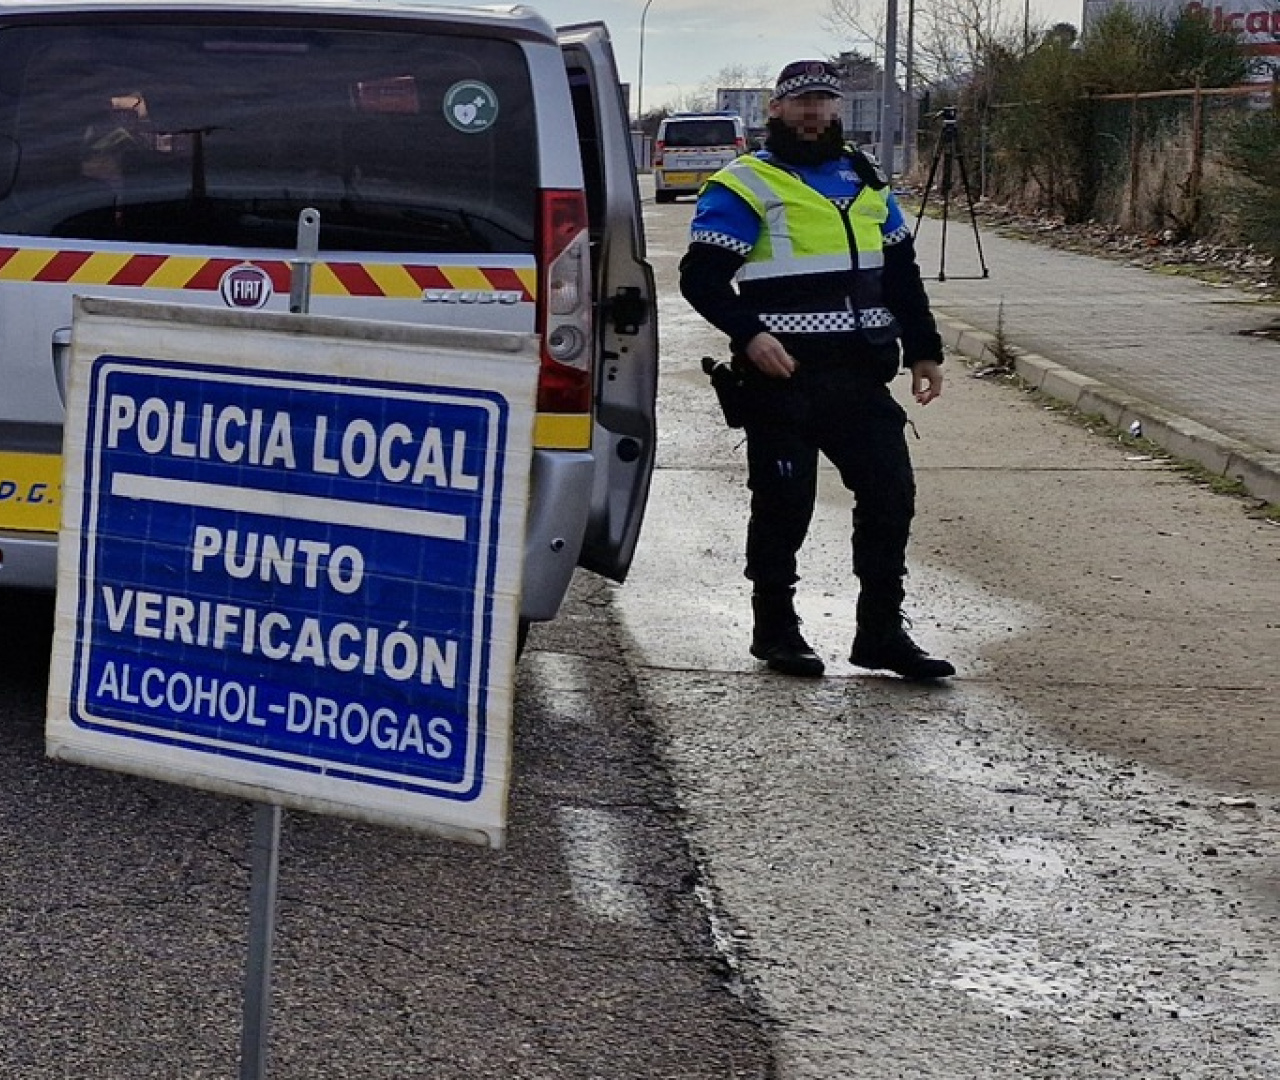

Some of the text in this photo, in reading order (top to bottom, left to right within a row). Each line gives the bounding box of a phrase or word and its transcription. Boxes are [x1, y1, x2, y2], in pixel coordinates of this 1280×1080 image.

[233, 279, 261, 300] FIAT
[106, 394, 480, 491] POLICIA LOCAL
[192, 526, 364, 594] PUNTO
[102, 587, 458, 688] VERIFICACIÓN
[96, 660, 452, 760] ALCOHOL-DROGAS
